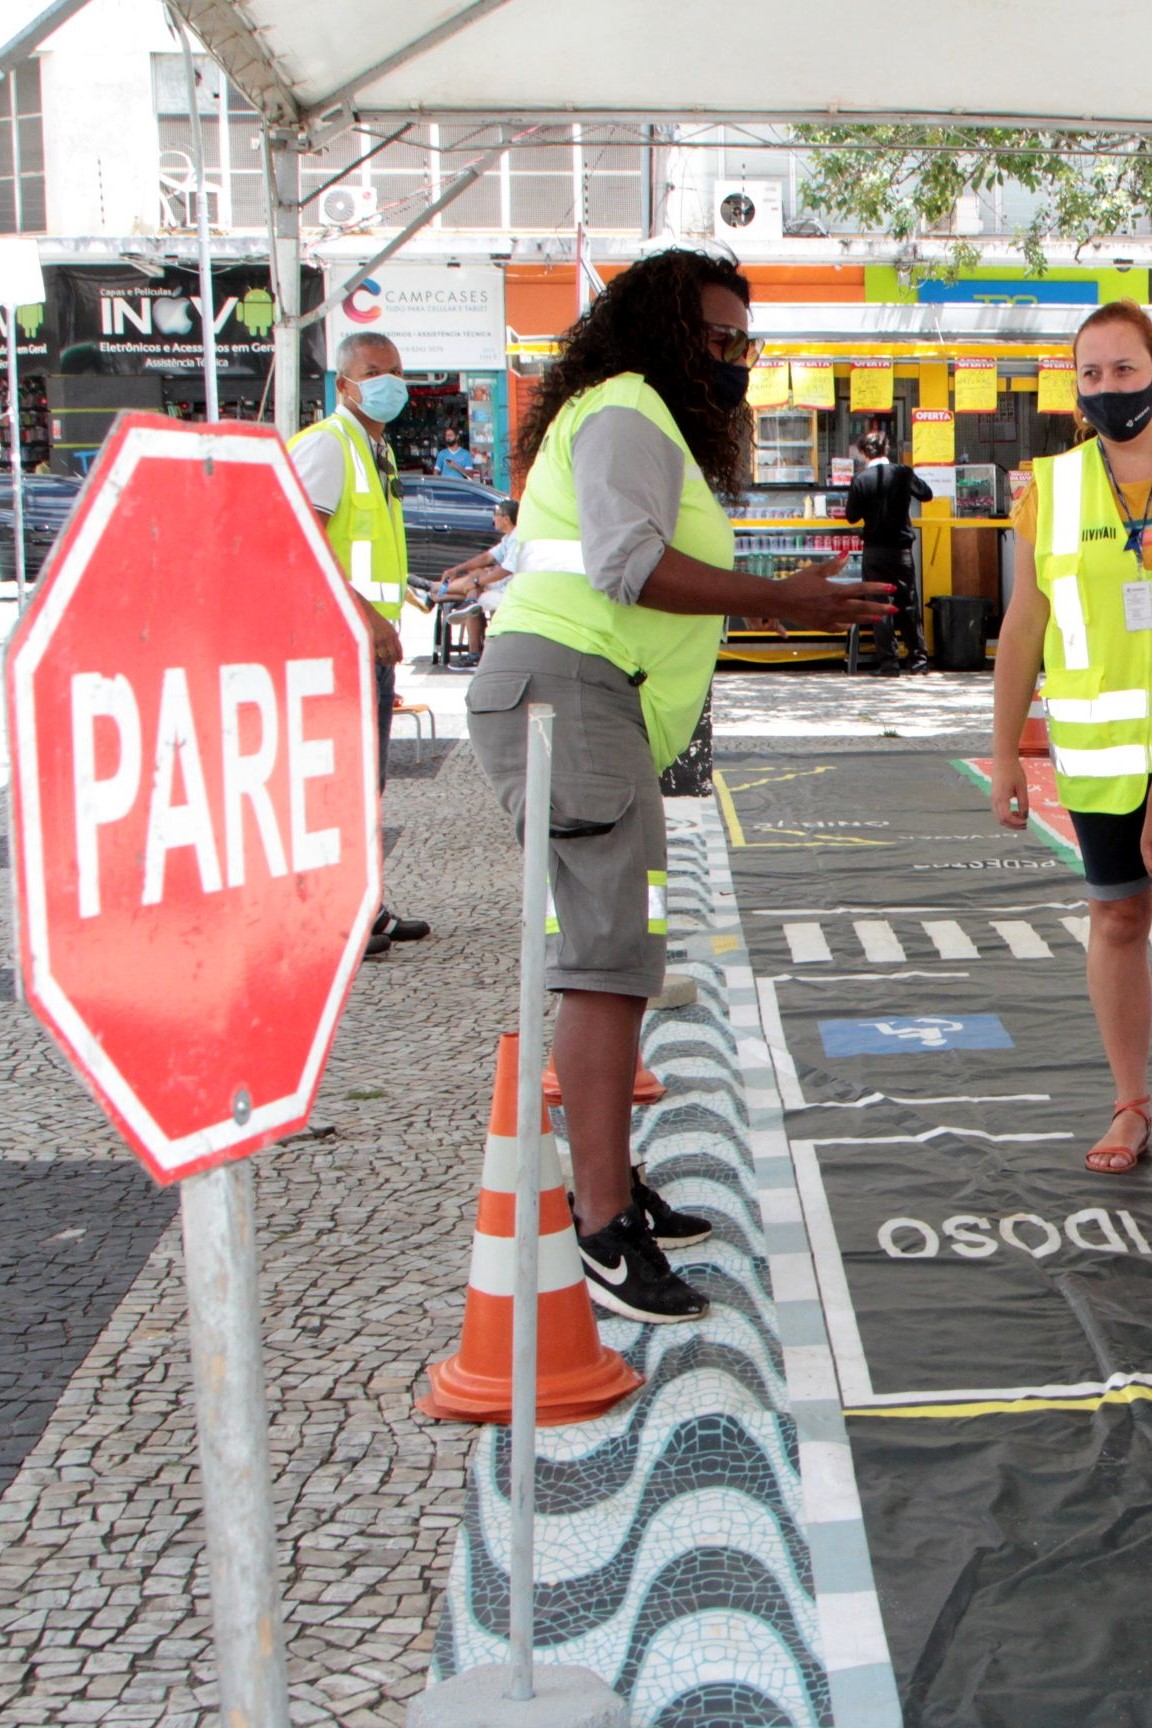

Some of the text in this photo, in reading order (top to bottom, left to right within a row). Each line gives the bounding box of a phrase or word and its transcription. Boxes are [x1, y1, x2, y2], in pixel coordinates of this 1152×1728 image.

[100, 288, 125, 297] Capas
[385, 290, 488, 303] CAMPCASES
[99, 341, 161, 353] Eletrônicos
[163, 344, 171, 353] e
[231, 344, 250, 353] em
[145, 357, 195, 368] Assistência
[915, 411, 951, 421] OFERTA
[71, 657, 341, 919] PARE
[878, 1207, 1152, 1259] IDOSO
